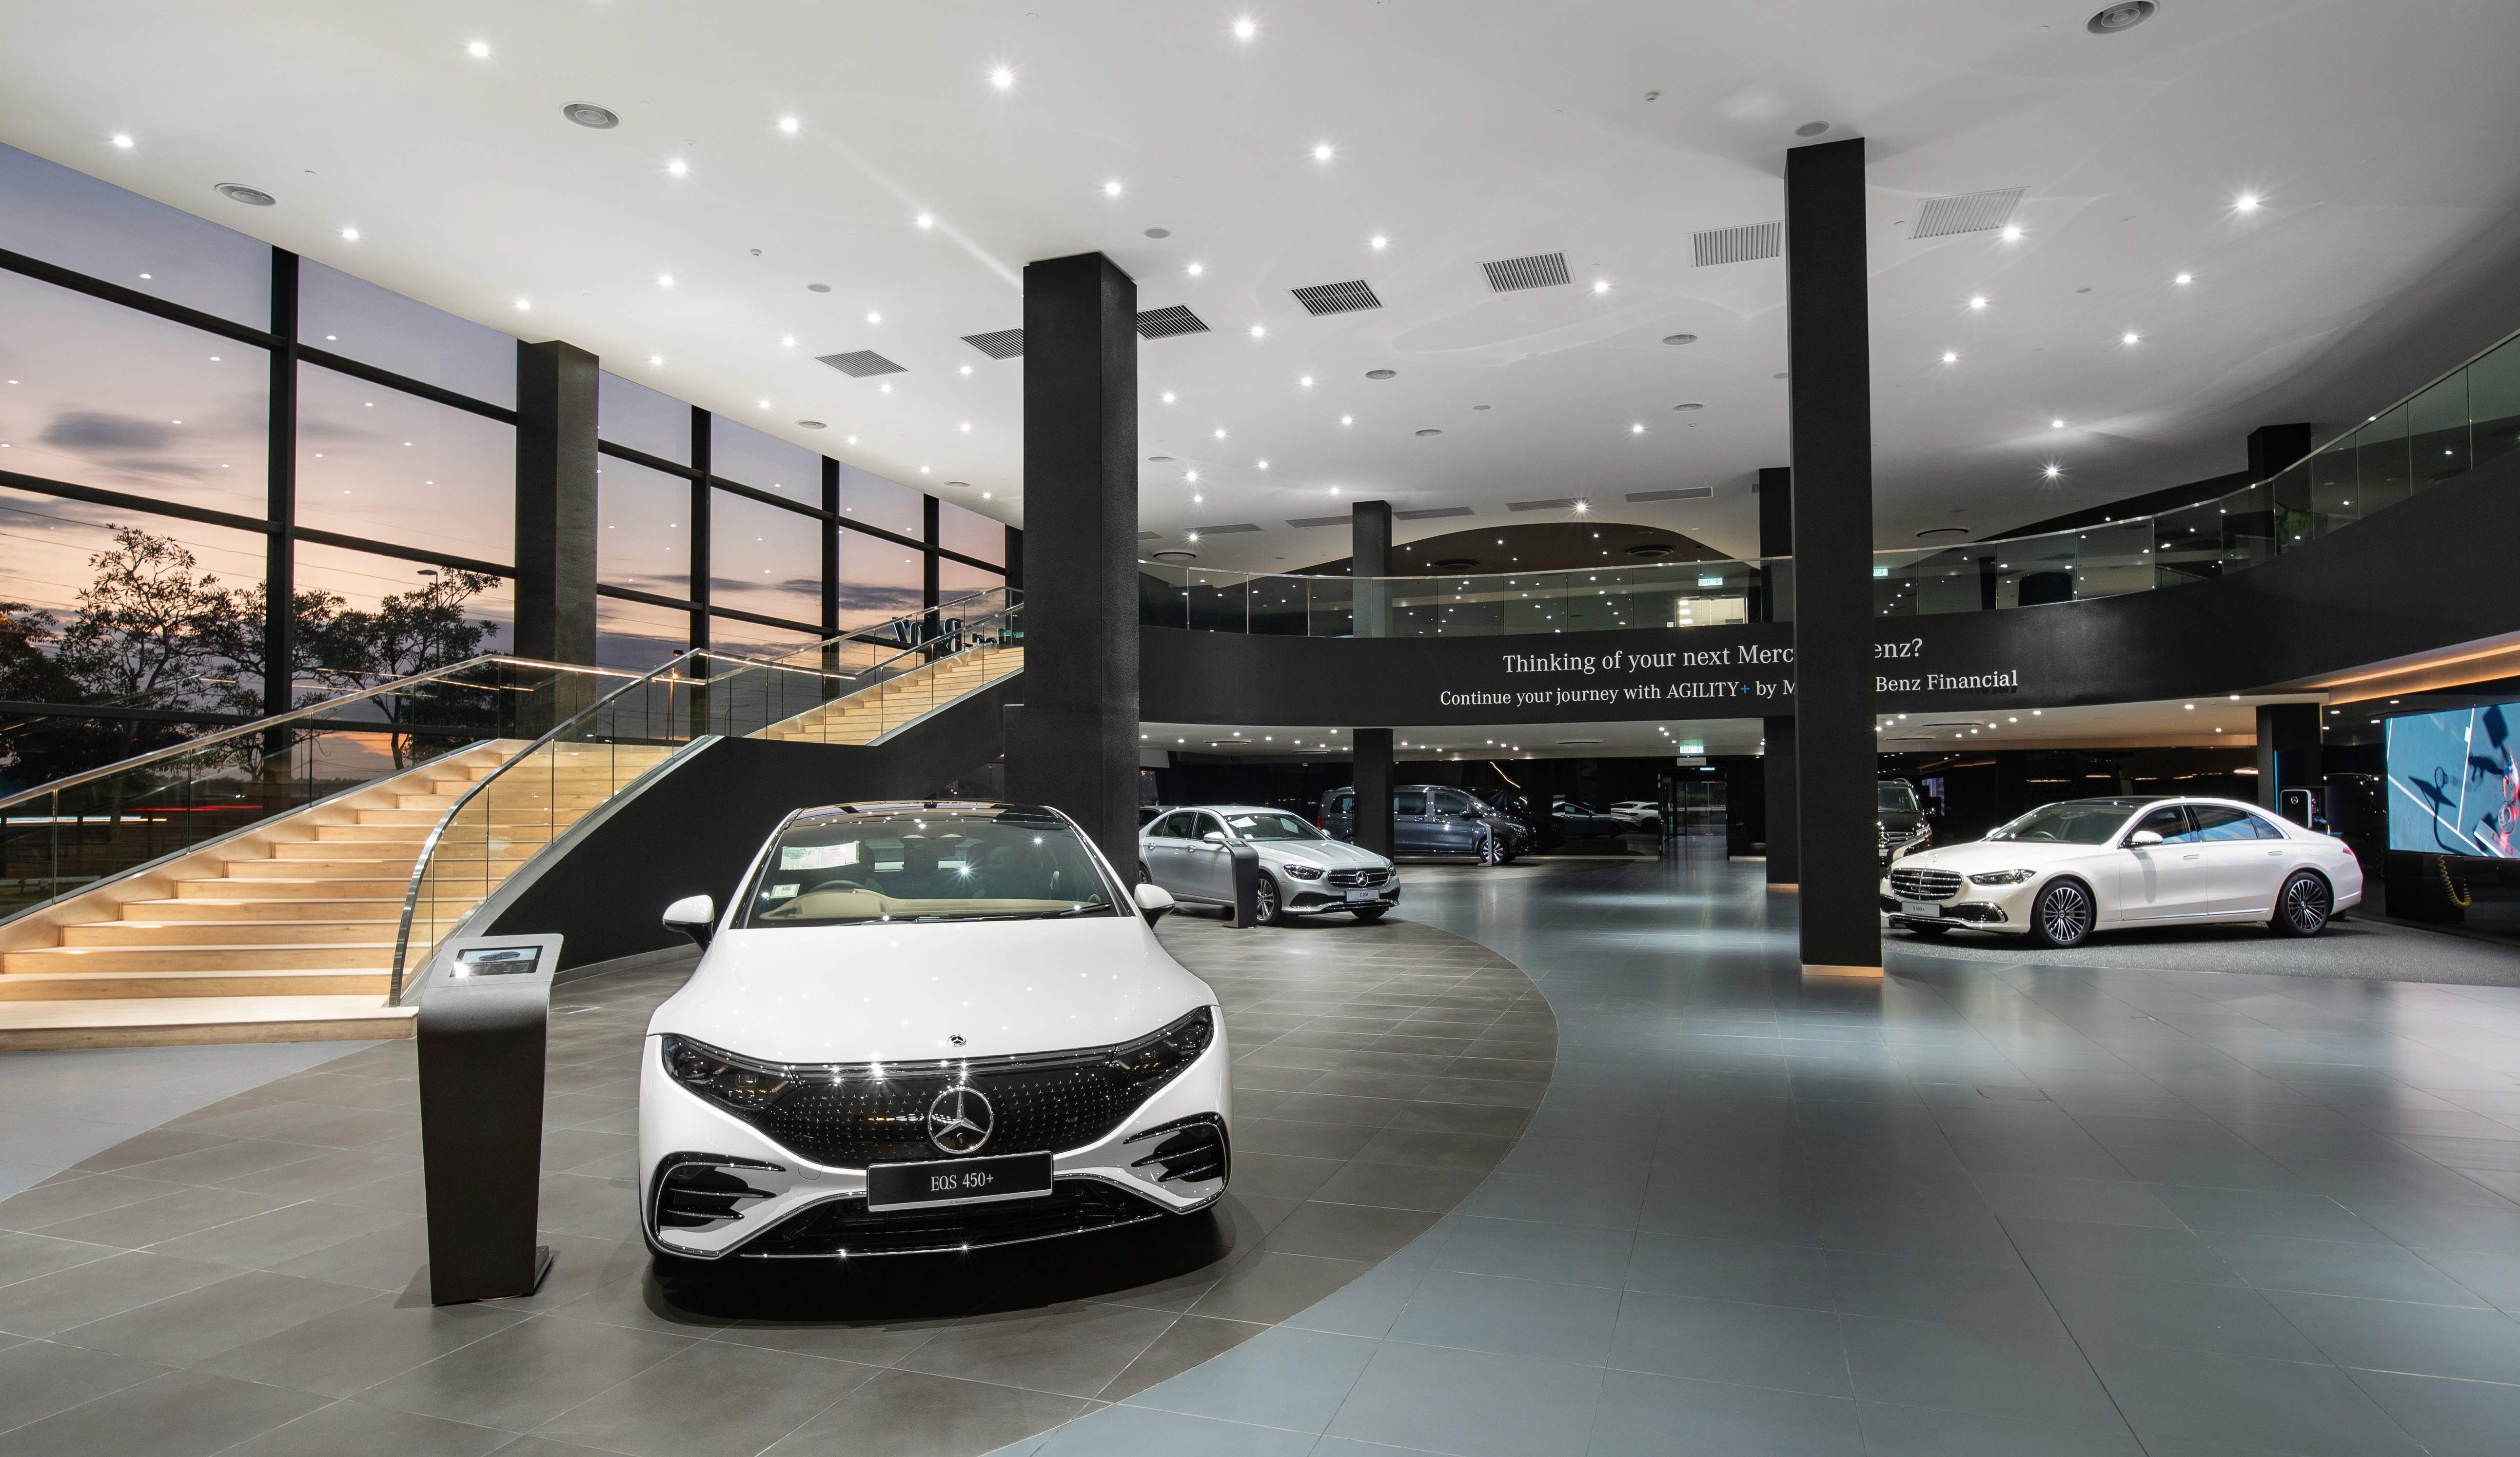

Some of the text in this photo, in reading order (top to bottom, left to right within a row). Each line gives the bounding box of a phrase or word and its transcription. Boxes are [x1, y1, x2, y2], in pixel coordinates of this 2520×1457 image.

[1503, 653, 1596, 674] Thinking
[1602, 650, 1623, 669] of
[1627, 653, 1676, 673] your
[1683, 648, 1731, 666] next
[1440, 689, 1511, 705] Continue
[1516, 691, 1553, 707] your
[1555, 688, 1619, 706] journey
[1623, 684, 1661, 700] with
[1666, 681, 1750, 698] AGILITY+
[1755, 680, 1777, 699] by
[1927, 669, 2018, 690] Financial
[931, 1172, 994, 1191] EQS 450+
